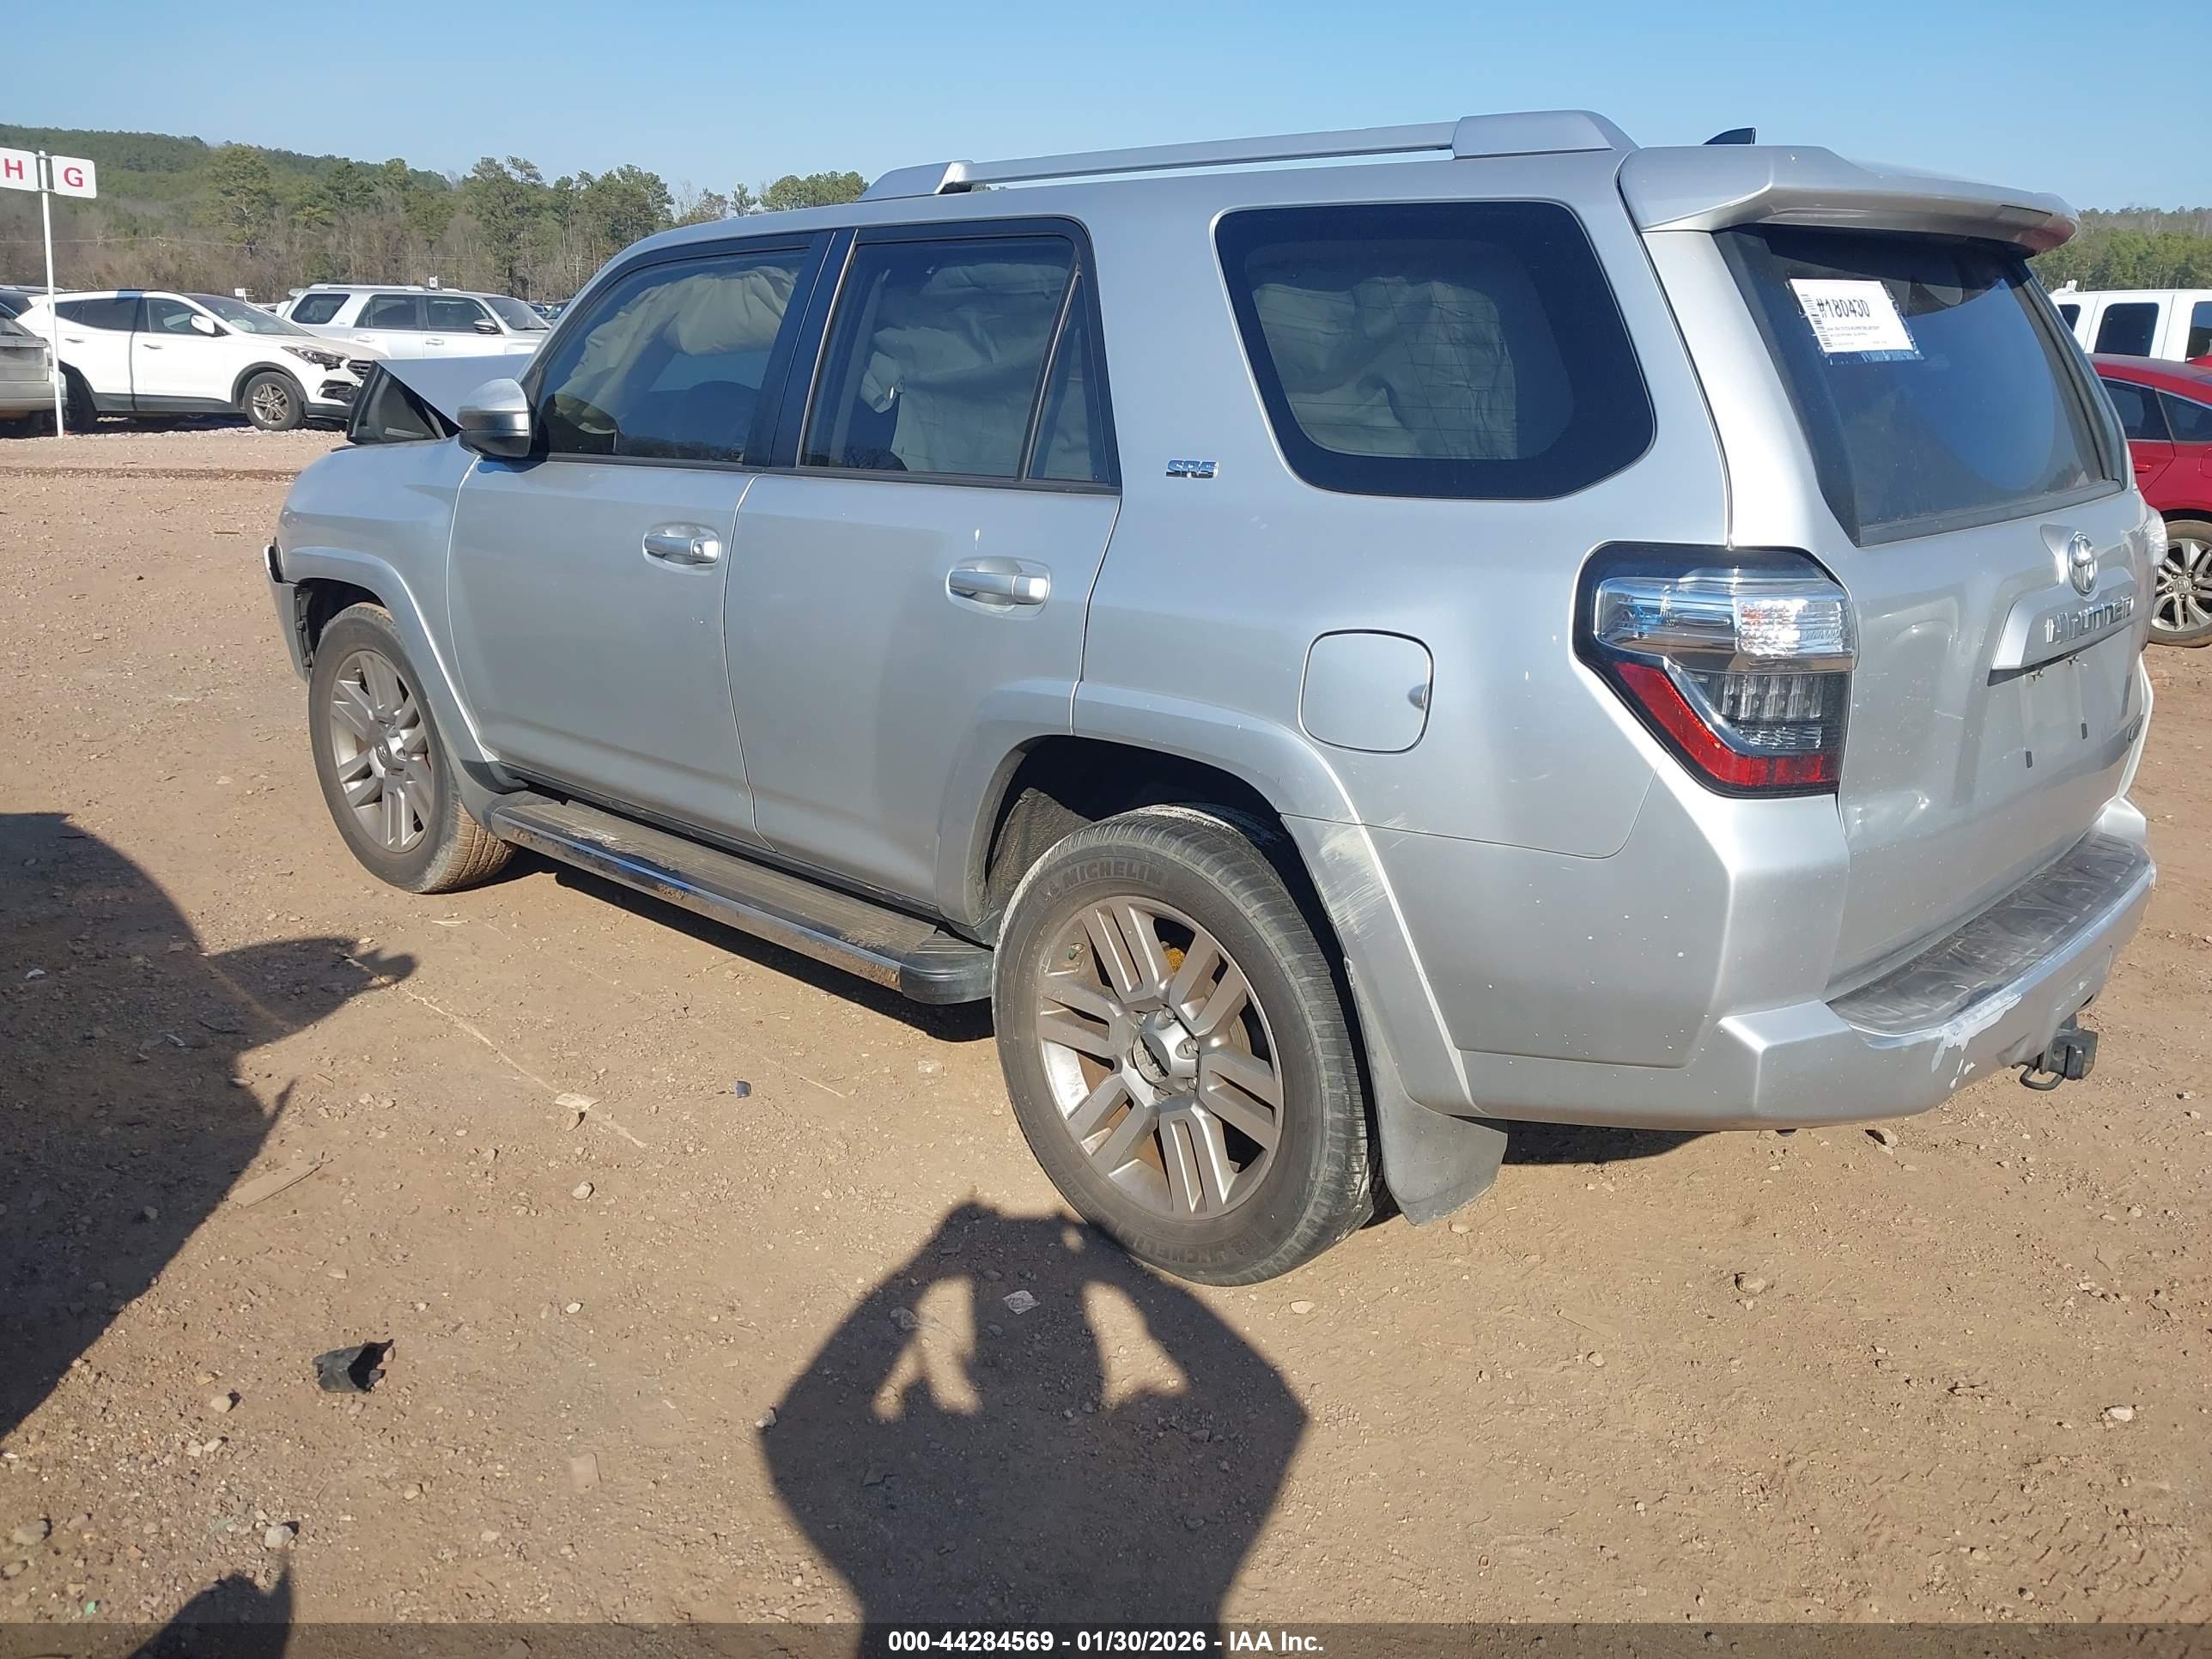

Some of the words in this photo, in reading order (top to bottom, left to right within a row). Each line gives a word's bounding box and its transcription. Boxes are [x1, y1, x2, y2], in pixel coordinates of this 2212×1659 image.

[4, 158, 23, 179] H
[64, 167, 83, 187] G
[1816, 297, 1870, 320] #180430
[1060, 859, 1164, 893] MICHELIN
